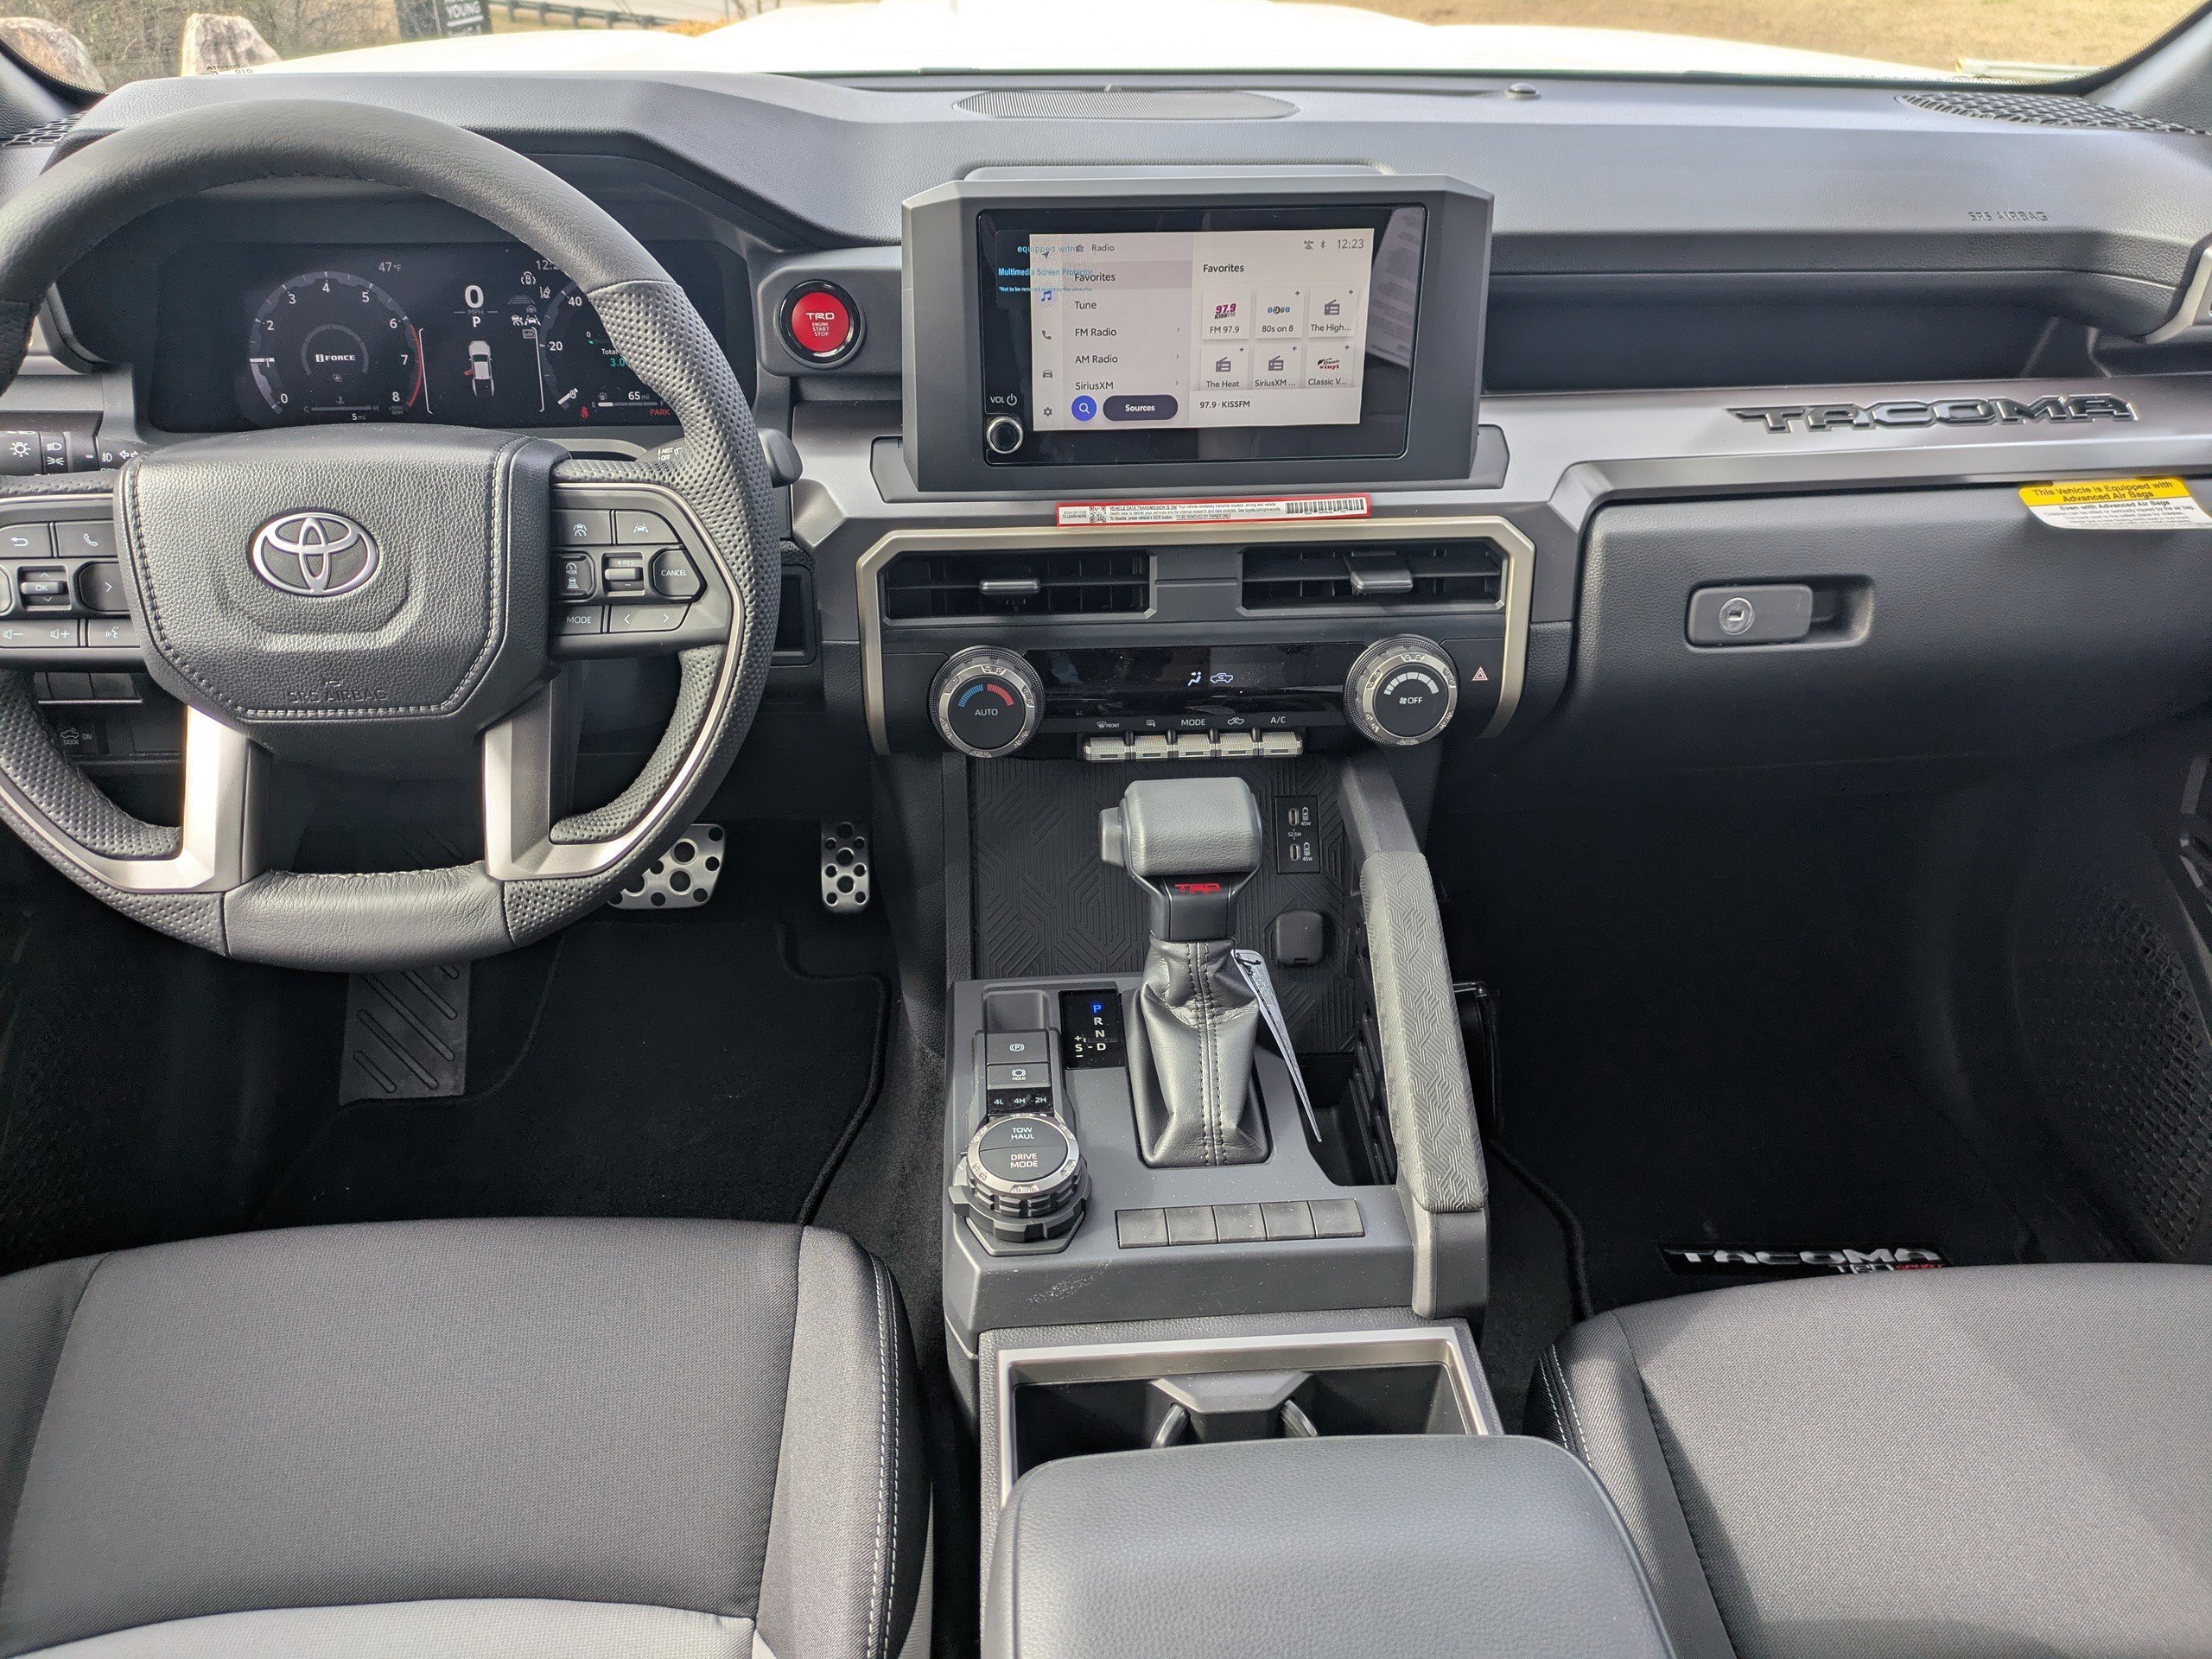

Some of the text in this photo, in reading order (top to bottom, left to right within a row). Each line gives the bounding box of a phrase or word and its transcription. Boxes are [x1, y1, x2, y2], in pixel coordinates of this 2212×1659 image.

[445, 2, 482, 18] YOUNG
[1968, 211, 2049, 221] SRS AIRBAG
[1091, 244, 1115, 252] Radio
[1337, 238, 1364, 250] 12:23
[1017, 245, 1054, 254] equipped
[998, 267, 1035, 276] Multimedia
[1203, 264, 1244, 273] Favorites
[1074, 272, 1116, 282] Favorites
[322, 283, 330, 292] 4
[289, 294, 296, 304] 3
[362, 292, 370, 302] 5
[464, 285, 484, 308] 0
[568, 296, 582, 307] 40
[1074, 301, 1097, 309] Tune
[1215, 303, 1236, 315] 97.9
[805, 312, 835, 321] TRD
[266, 321, 274, 330] 2
[390, 319, 397, 328] 6
[473, 316, 480, 327] P
[1075, 327, 1117, 337] FM Radio
[1223, 325, 1240, 334] 97.9
[1310, 323, 1325, 332] The
[549, 340, 563, 351] 20
[401, 355, 409, 365] 7
[1075, 354, 1118, 364] AM Radio
[1075, 381, 1114, 390] SiriusXM
[1308, 378, 1334, 386] Classic
[280, 394, 289, 403] 0
[392, 391, 400, 402] 8
[627, 391, 641, 400] 65
[989, 396, 1005, 404] VOL
[1124, 404, 1156, 412] Sources
[1221, 400, 1250, 409] KISSFM
[1726, 393, 2139, 434] TACOMA
[2056, 486, 2091, 495] Vehicle
[2103, 483, 2151, 493] Equipped
[2063, 493, 2111, 502] Advanced
[35, 583, 48, 592] OK
[1407, 696, 1423, 705] OFF
[975, 708, 999, 716] AUTO
[1181, 718, 1205, 727] MODE
[1270, 715, 1286, 725] A/C
[1174, 882, 1221, 895] TRD
[1093, 1004, 1102, 1013] P
[1094, 1017, 1103, 1026] R
[1096, 1029, 1105, 1038] N
[1075, 1043, 1083, 1052] S
[1664, 1248, 1942, 1264] TACOMA
